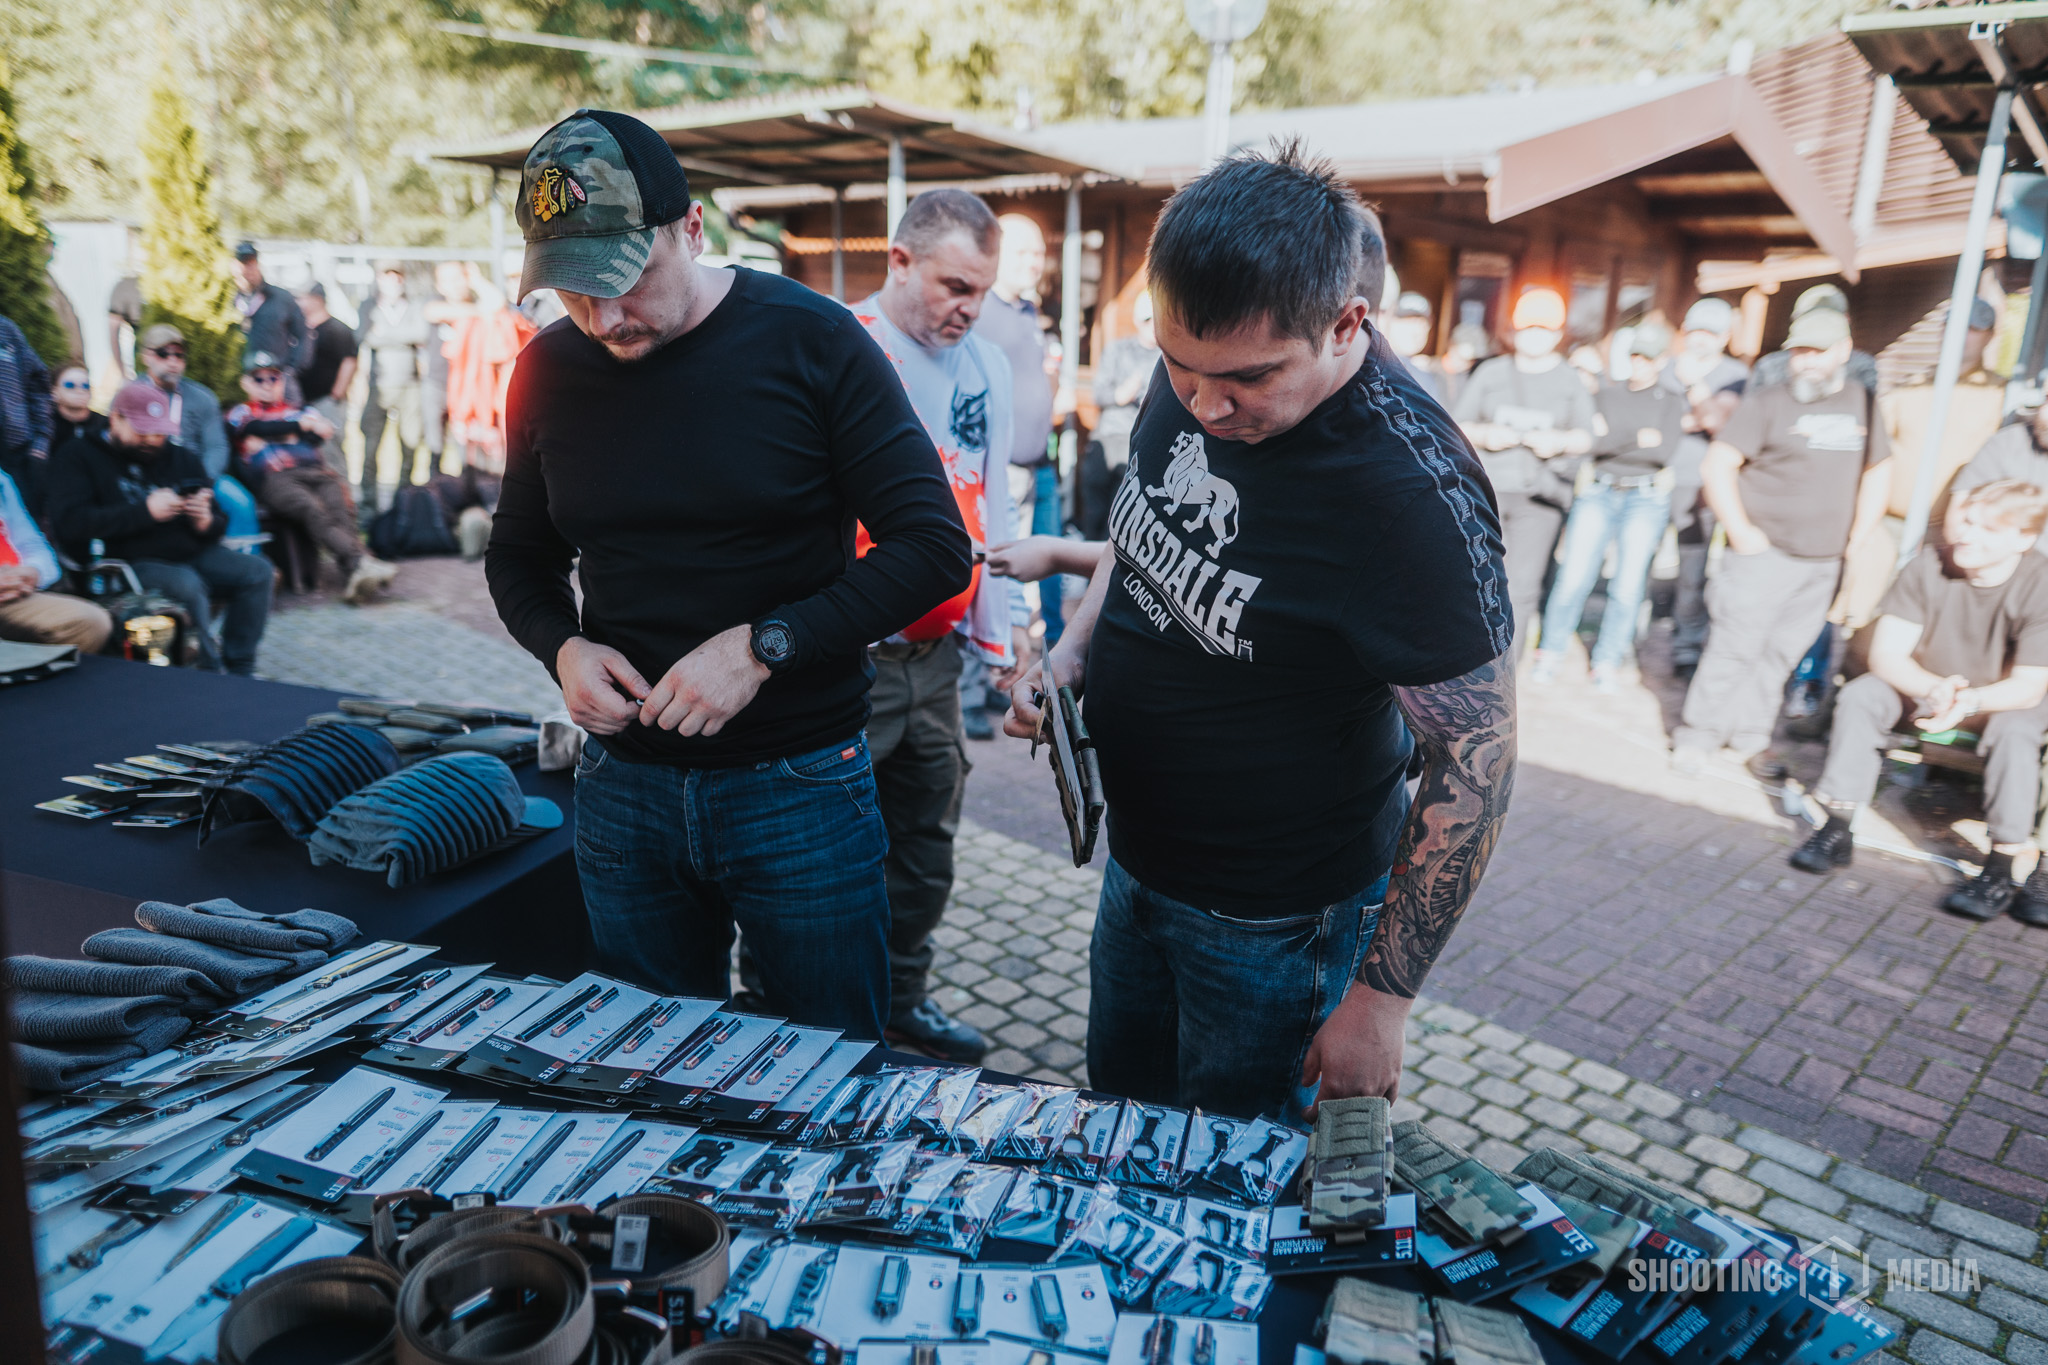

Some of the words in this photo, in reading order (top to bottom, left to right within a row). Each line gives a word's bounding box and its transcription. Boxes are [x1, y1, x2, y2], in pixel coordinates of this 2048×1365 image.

[1446, 487, 1471, 522] LONSDALE
[1123, 572, 1172, 632] LONDON
[538, 1067, 558, 1080] 5.11
[620, 1077, 638, 1089] 5.11
[679, 1092, 695, 1105] 5.11
[748, 1107, 766, 1120] 5.11
[1084, 1161, 1098, 1177] 5.11
[323, 1183, 341, 1199] 5.11
[171, 1200, 196, 1214] 5.11
[866, 1201, 885, 1216] 5.11
[894, 1215, 914, 1231] 5.11
[1273, 1239, 1300, 1249] POUCH
[1564, 1228, 1594, 1253] 5.11
[1273, 1248, 1292, 1257] MAG
[1293, 1246, 1304, 1255] AR
[1304, 1245, 1323, 1253] FLEX
[1395, 1239, 1413, 1259] 5.11
[1664, 1239, 1700, 1264] 5.11
[1467, 1266, 1480, 1276] AR
[1480, 1259, 1499, 1272] FLEX
[1449, 1271, 1470, 1284] MAG
[1807, 1261, 1847, 1290] 5.11
[668, 1295, 685, 1326] 5.11
[1603, 1299, 1623, 1317] FLEX
[1582, 1320, 1603, 1340] MAG
[1687, 1314, 1710, 1334] FLEX
[1851, 1310, 1892, 1338] 5.11
[1662, 1335, 1685, 1357] MAG
